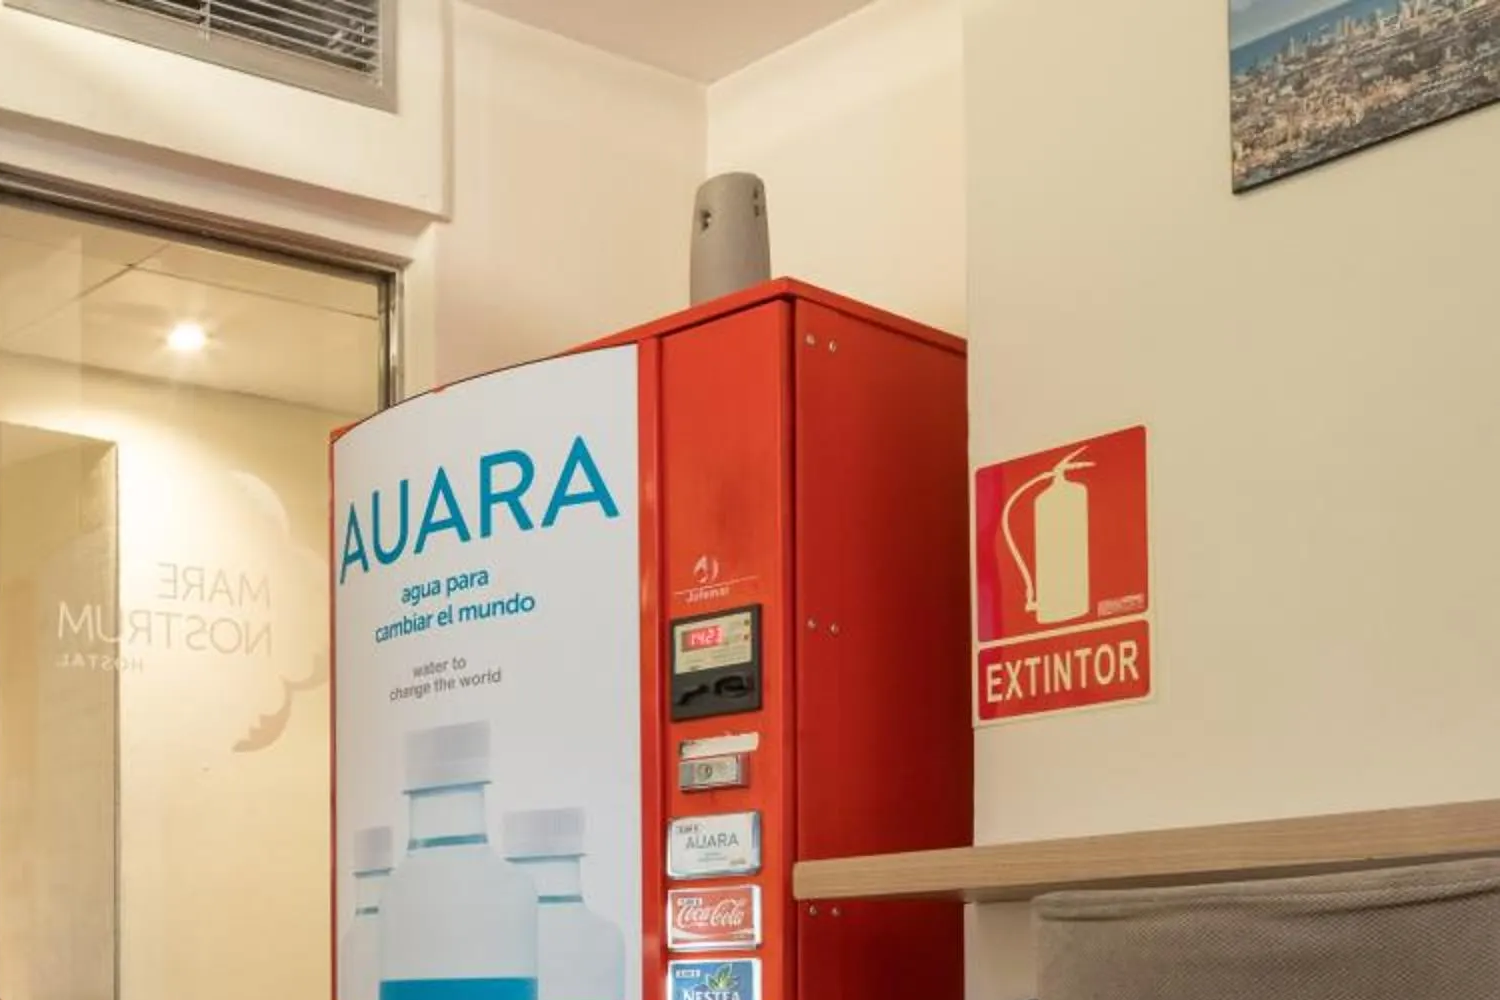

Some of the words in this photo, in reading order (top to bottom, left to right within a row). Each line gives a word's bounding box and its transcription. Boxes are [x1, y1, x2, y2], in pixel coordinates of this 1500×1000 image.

[340, 436, 620, 584] AUARA
[401, 582, 441, 606] agua
[446, 569, 489, 597] para
[374, 610, 433, 643] cambiar
[437, 609, 453, 628] el
[458, 594, 535, 620] mundo
[389, 682, 431, 702] change
[433, 677, 456, 693] the
[458, 668, 502, 688] world
[412, 658, 447, 679] water
[451, 656, 467, 671] to
[986, 639, 1139, 704] EXTINTOR
[685, 832, 739, 849] AUARA
